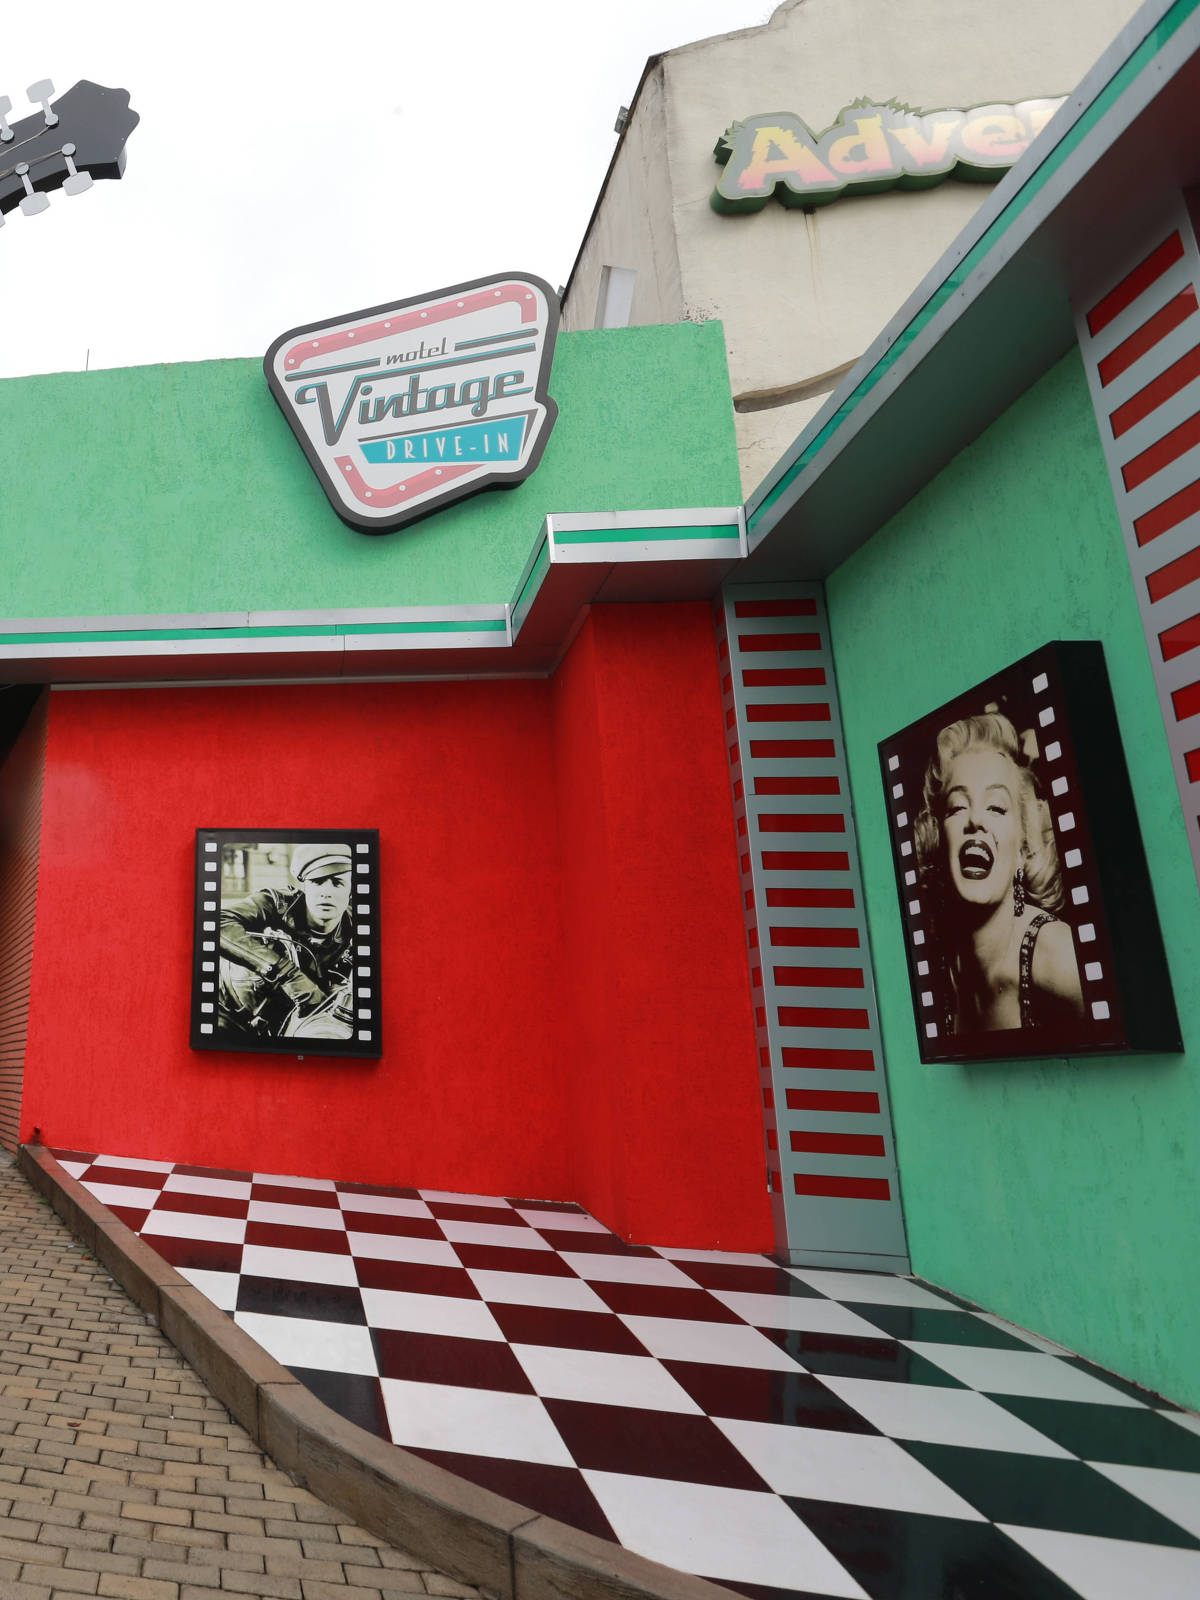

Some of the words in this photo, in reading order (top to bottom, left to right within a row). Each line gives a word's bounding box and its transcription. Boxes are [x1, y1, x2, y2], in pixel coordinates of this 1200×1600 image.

[386, 338, 449, 365] motel
[295, 370, 533, 446] Vintage
[386, 432, 510, 461] DRIVE-IN
